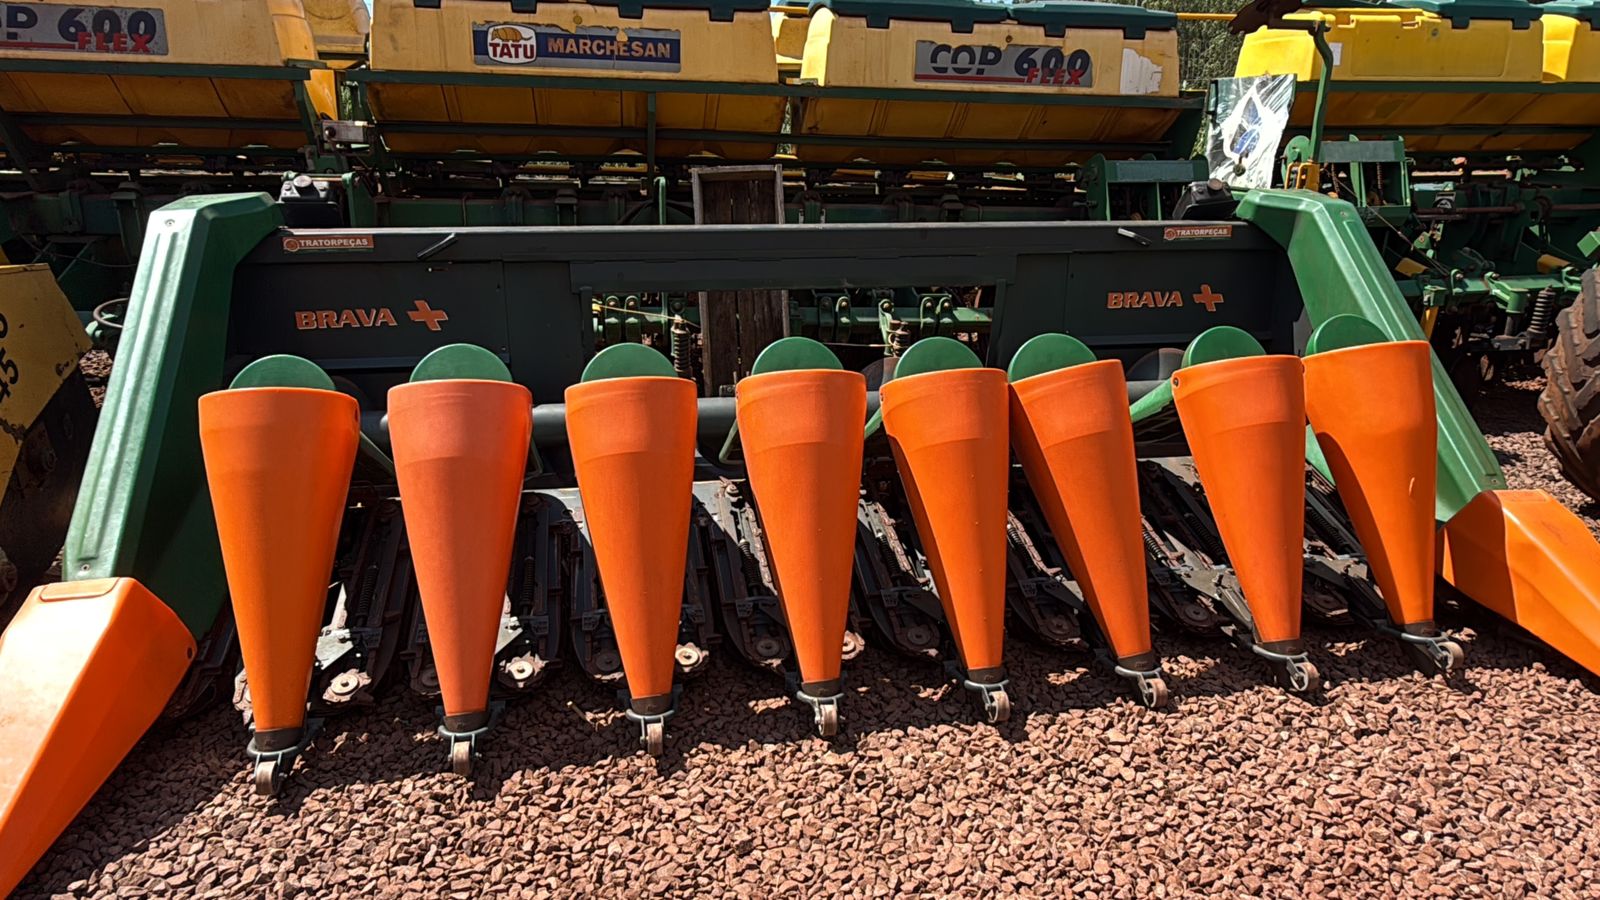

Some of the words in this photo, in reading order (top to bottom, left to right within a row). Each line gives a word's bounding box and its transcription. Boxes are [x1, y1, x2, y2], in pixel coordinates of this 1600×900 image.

[0, 5, 38, 41] P
[58, 8, 157, 43] 600
[77, 31, 151, 53] FLEX
[489, 42, 535, 60] TATU
[547, 37, 671, 59] MARCHESAN
[930, 44, 1002, 76] COP
[1014, 47, 1091, 78] 600
[1025, 67, 1082, 85] FLEX
[1176, 228, 1228, 236] TRATORPEÇAS
[300, 238, 368, 248] TRATORPEÇAS
[1107, 291, 1184, 309] BRAVA
[295, 308, 398, 330] BRAVA
